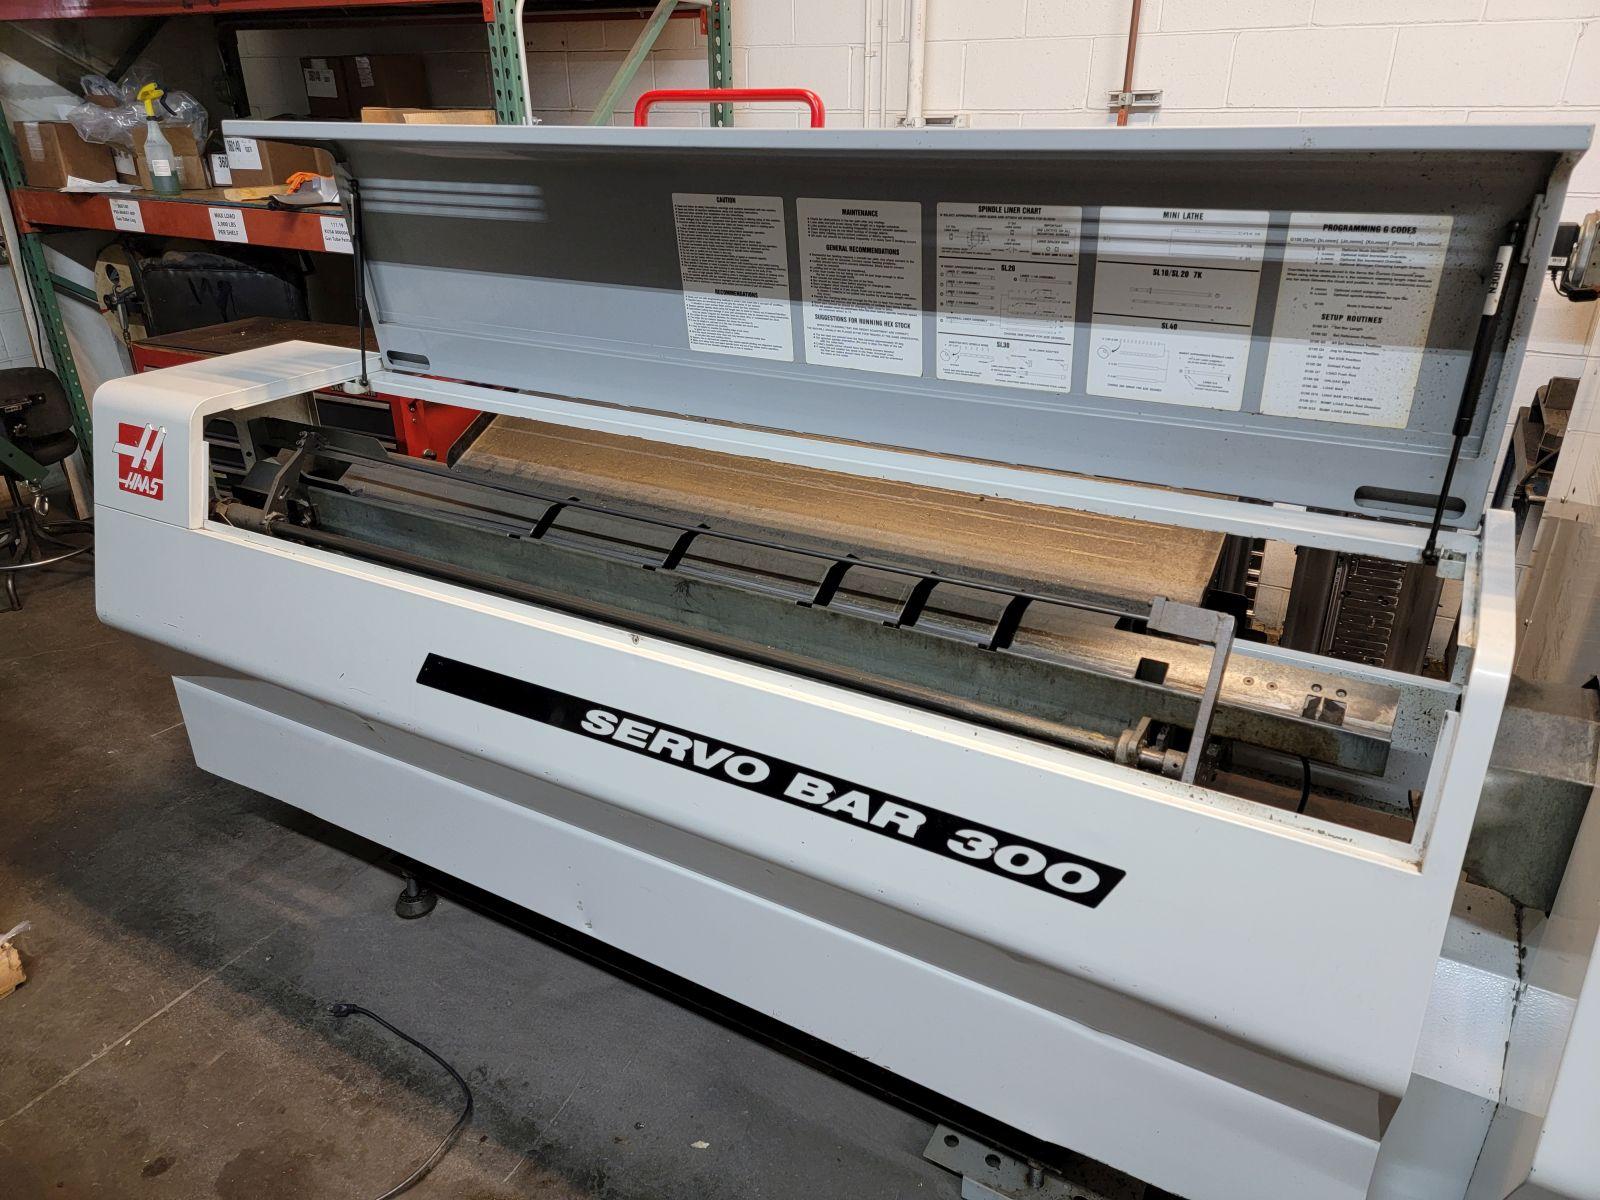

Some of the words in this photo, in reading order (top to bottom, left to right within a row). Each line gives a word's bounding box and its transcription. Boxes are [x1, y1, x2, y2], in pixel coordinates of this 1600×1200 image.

[716, 196, 737, 204] CAUTION
[841, 208, 879, 218] MAINTENANCE
[978, 205, 1003, 214] SPINDLE
[1003, 206, 1021, 215] LINER
[1022, 207, 1042, 215] CHART
[1163, 211, 1180, 220] MINI
[1182, 211, 1204, 221] LATHE
[1322, 223, 1381, 234] PROGRAMMING
[1391, 226, 1418, 235] CODES
[825, 244, 848, 253] GENERAL
[848, 246, 900, 256] RECOMMENDATIONS
[1000, 264, 1016, 272] SL20
[1193, 271, 1203, 279] 7K
[715, 288, 759, 299] RECOMMENDATIONS
[814, 313, 848, 324] SUGGESTIONS
[848, 317, 859, 325] FOR
[859, 318, 883, 328] RUNNING
[883, 320, 894, 328] HEX
[894, 321, 911, 330] STOCK
[1320, 313, 1344, 322] SETUP
[1346, 315, 1383, 324] ROUTINES
[1161, 322, 1178, 330] SL40
[119, 472, 164, 496] HAAS
[580, 708, 771, 784] SERVO
[783, 771, 926, 838] BAR
[946, 828, 1101, 894] 300
